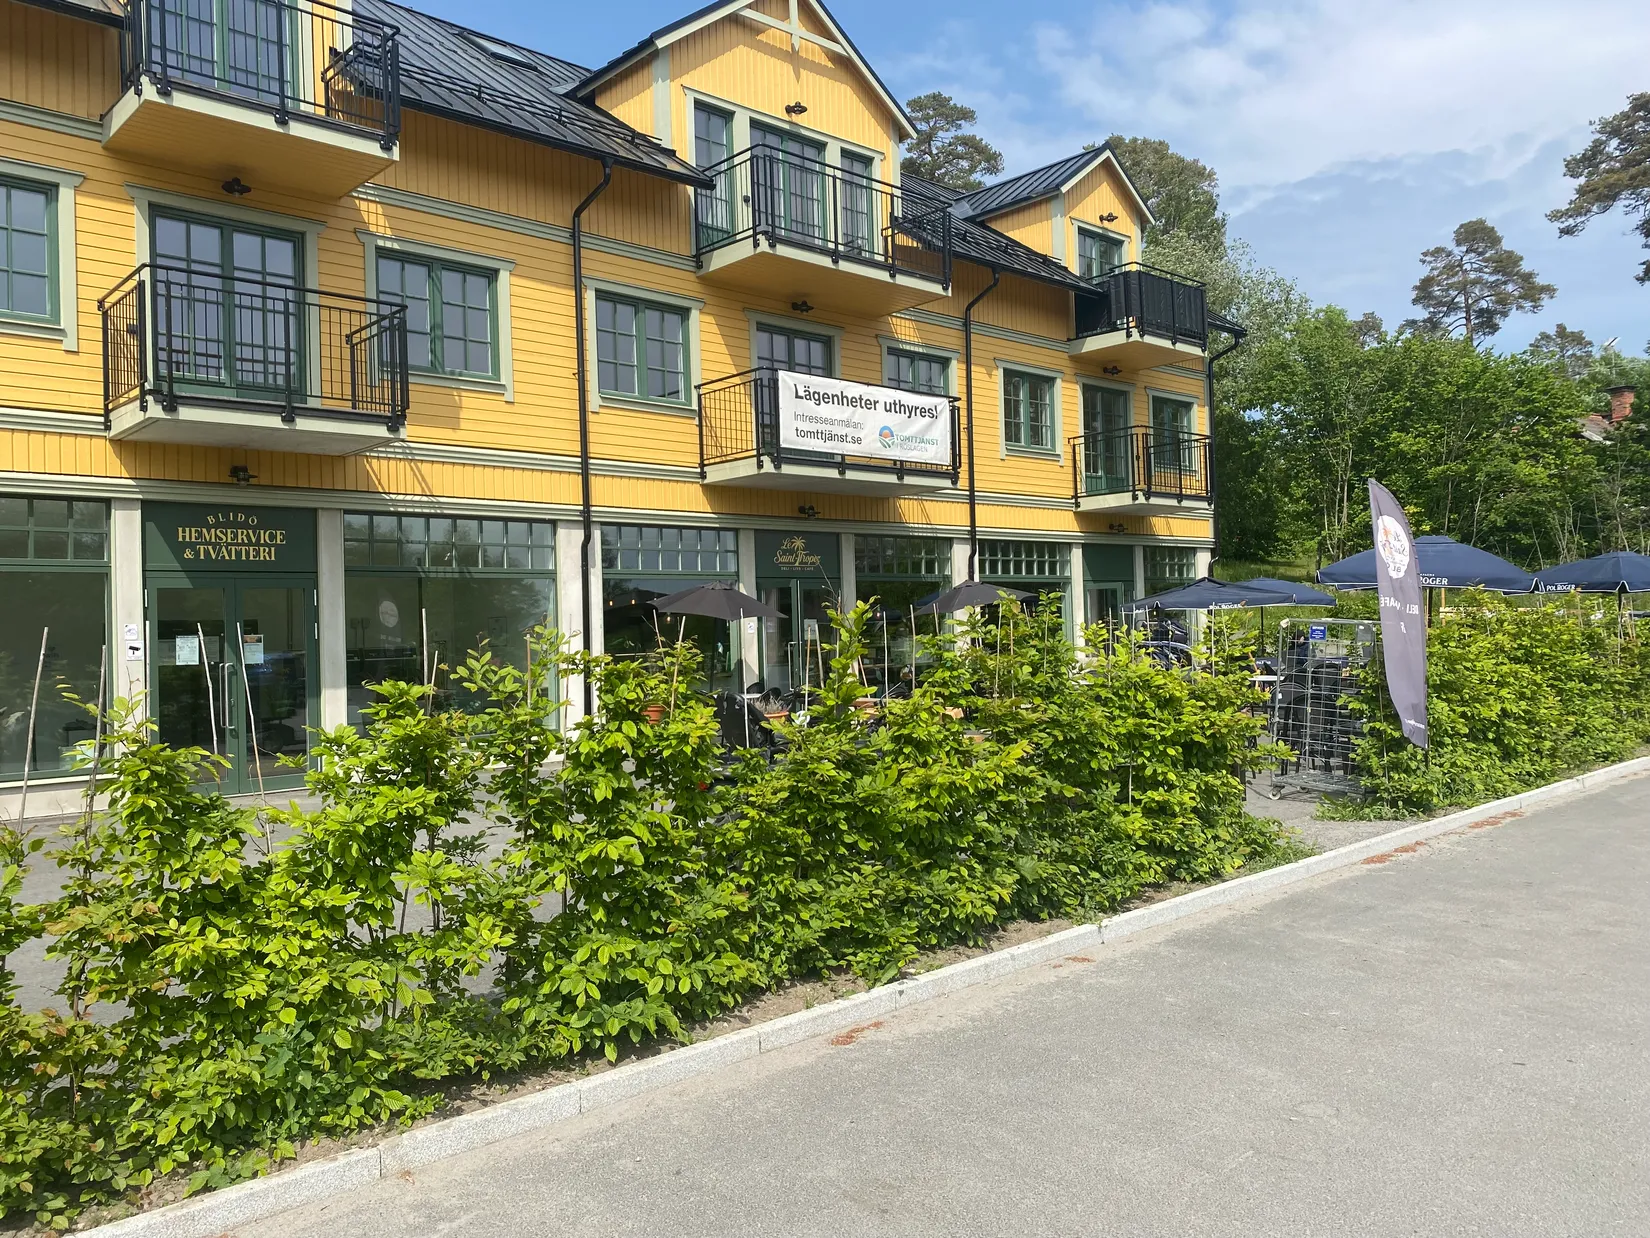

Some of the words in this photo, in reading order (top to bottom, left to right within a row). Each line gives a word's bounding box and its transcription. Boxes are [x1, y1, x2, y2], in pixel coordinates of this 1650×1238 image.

[794, 384, 879, 410] Lägenheter
[884, 399, 938, 419] uthyres!
[794, 411, 864, 430] Intresseanmälan:
[795, 426, 862, 445] tomttjänst.se
[207, 512, 258, 525] BLIDÖ
[177, 527, 286, 544] HEMSERVICE
[781, 538, 792, 549] Le
[183, 548, 195, 559] &
[196, 543, 276, 561] TVÄTTERI
